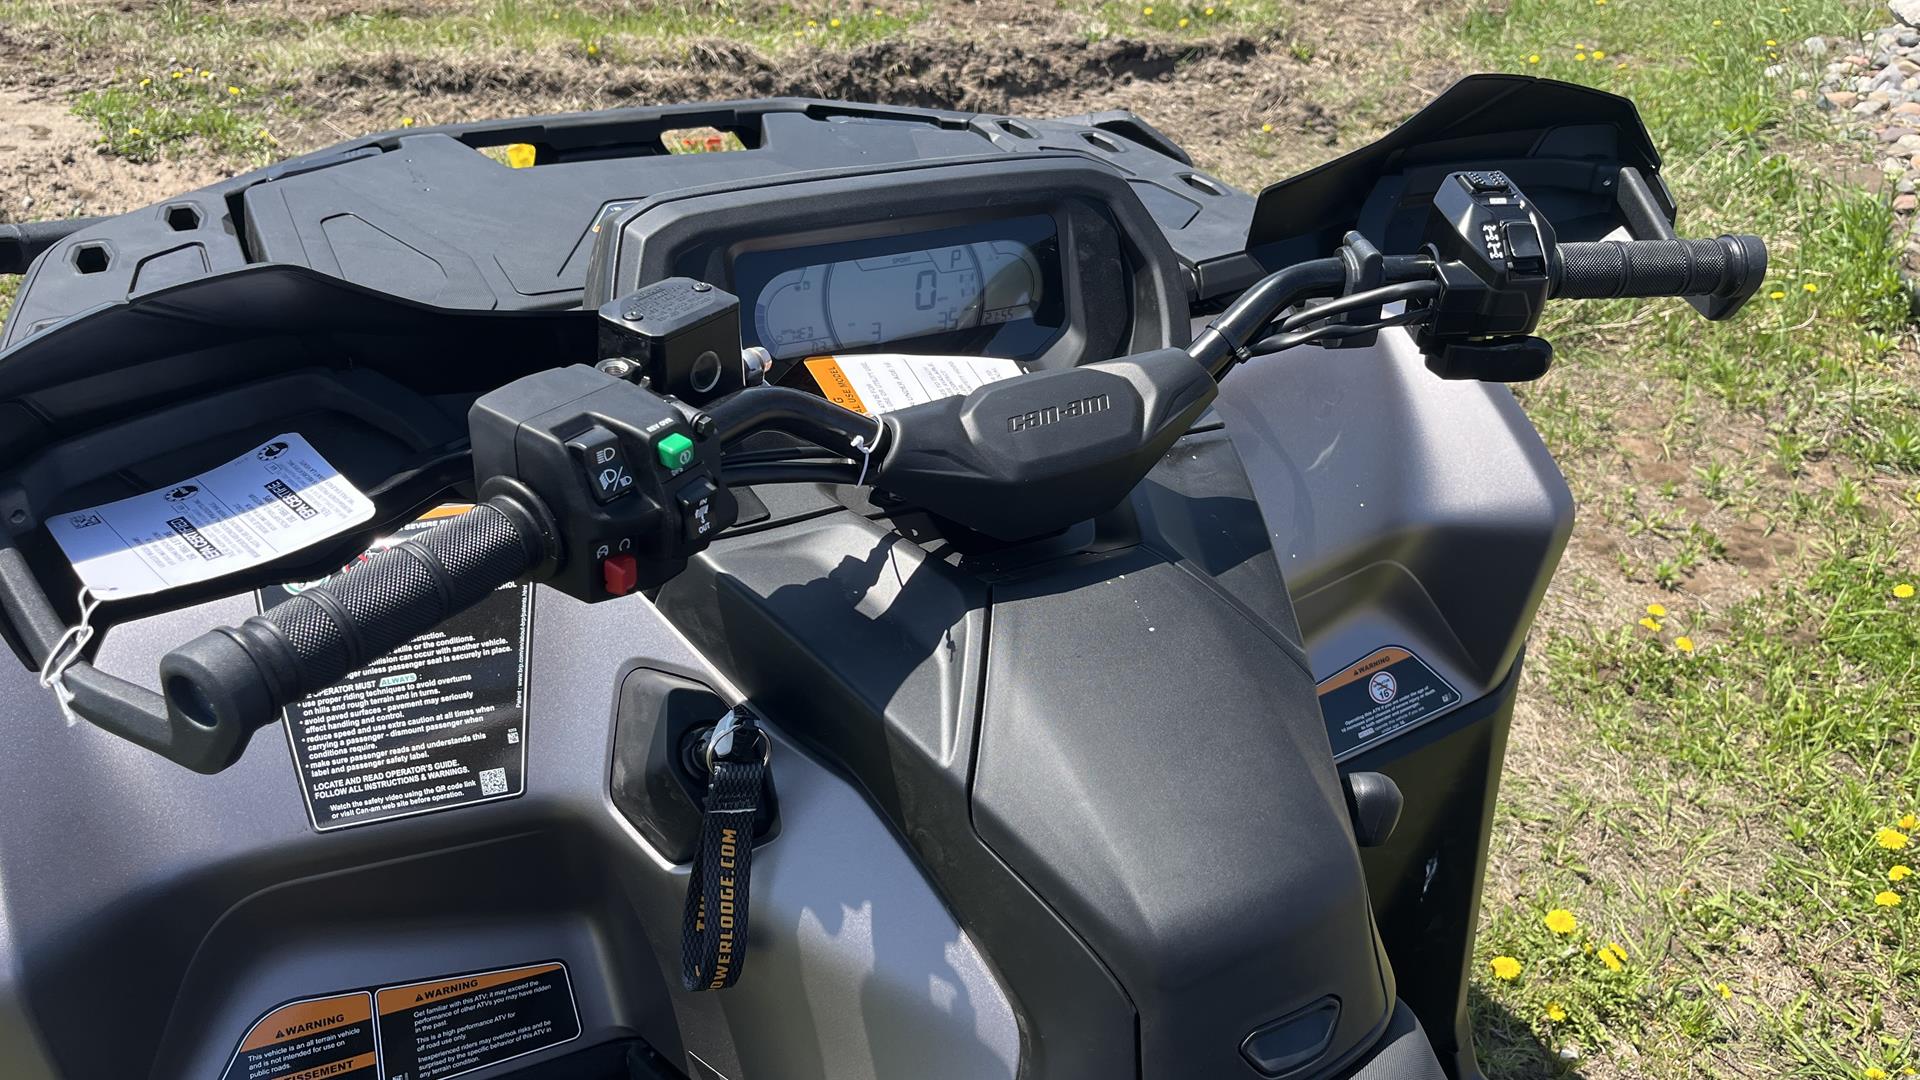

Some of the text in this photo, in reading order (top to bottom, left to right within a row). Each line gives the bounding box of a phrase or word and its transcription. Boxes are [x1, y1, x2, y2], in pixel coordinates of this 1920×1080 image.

[950, 250, 961, 268] P
[1008, 394, 1110, 433] can-am
[404, 520, 438, 530] SEVERE
[698, 522, 710, 534] OUT
[413, 650, 434, 658] occur
[435, 646, 451, 655] with
[452, 642, 480, 652] another
[480, 637, 508, 647] vehicle.
[435, 635, 475, 646] conditions.
[362, 666, 387, 676] unless
[387, 660, 425, 673] passenger
[426, 656, 442, 665] seat
[451, 650, 481, 661] securely
[491, 646, 512, 655] place.
[1358, 656, 1390, 674] WARNING
[317, 696, 342, 706] proper
[342, 692, 365, 701] riding
[365, 685, 406, 697] techniques
[416, 678, 436, 689] avoid
[437, 674, 472, 685] overturns
[354, 680, 376, 690] MUST
[381, 674, 416, 686] ALWAYS
[1379, 689, 1390, 699] 16
[304, 715, 325, 725] avoid
[325, 711, 348, 723] paved
[349, 707, 381, 717] surfaces
[387, 699, 423, 712] pavement
[440, 690, 473, 702] seriously
[306, 733, 332, 743] reduce
[333, 727, 356, 738] speed
[357, 725, 371, 734] and
[387, 720, 406, 729] extra
[407, 715, 434, 725] caution
[444, 711, 453, 719] all
[454, 709, 474, 717] times
[475, 705, 495, 713] when
[310, 732, 486, 768] make sure passenger reads and understands this
[313, 759, 459, 791] LOCATE AND READ OPERATOR'S GUIDE.
[314, 787, 347, 799] FOLLOW
[348, 784, 363, 793] ALL
[364, 774, 419, 791] INSTRUCTIONS
[427, 765, 470, 779] WARNINGS.
[329, 802, 351, 811] Watch
[363, 796, 384, 805] safety
[384, 793, 403, 801] video
[404, 790, 423, 798] using
[434, 784, 446, 792] QR
[446, 782, 463, 790] code
[424, 980, 478, 999] WARNING
[426, 1004, 448, 1014] familiar
[507, 982, 528, 992] exceed
[414, 1011, 452, 1027] performance
[460, 1004, 476, 1013] other
[476, 1000, 492, 1008] ATVs
[493, 997, 504, 1005] you
[533, 984, 551, 993] ridden
[286, 1014, 344, 1035] WARNING
[456, 1018, 493, 1034] performance
[494, 1014, 506, 1022] ATV
[263, 1047, 287, 1057] vehicle
[315, 1034, 336, 1044] terrain
[337, 1028, 360, 1038] vehicle
[417, 1046, 460, 1063] Inexperienced
[460, 1041, 478, 1050] riders
[492, 1030, 516, 1041] overlook
[532, 1021, 543, 1030] and
[248, 1061, 262, 1070] and
[270, 1056, 281, 1064] not
[282, 1048, 311, 1061] intended
